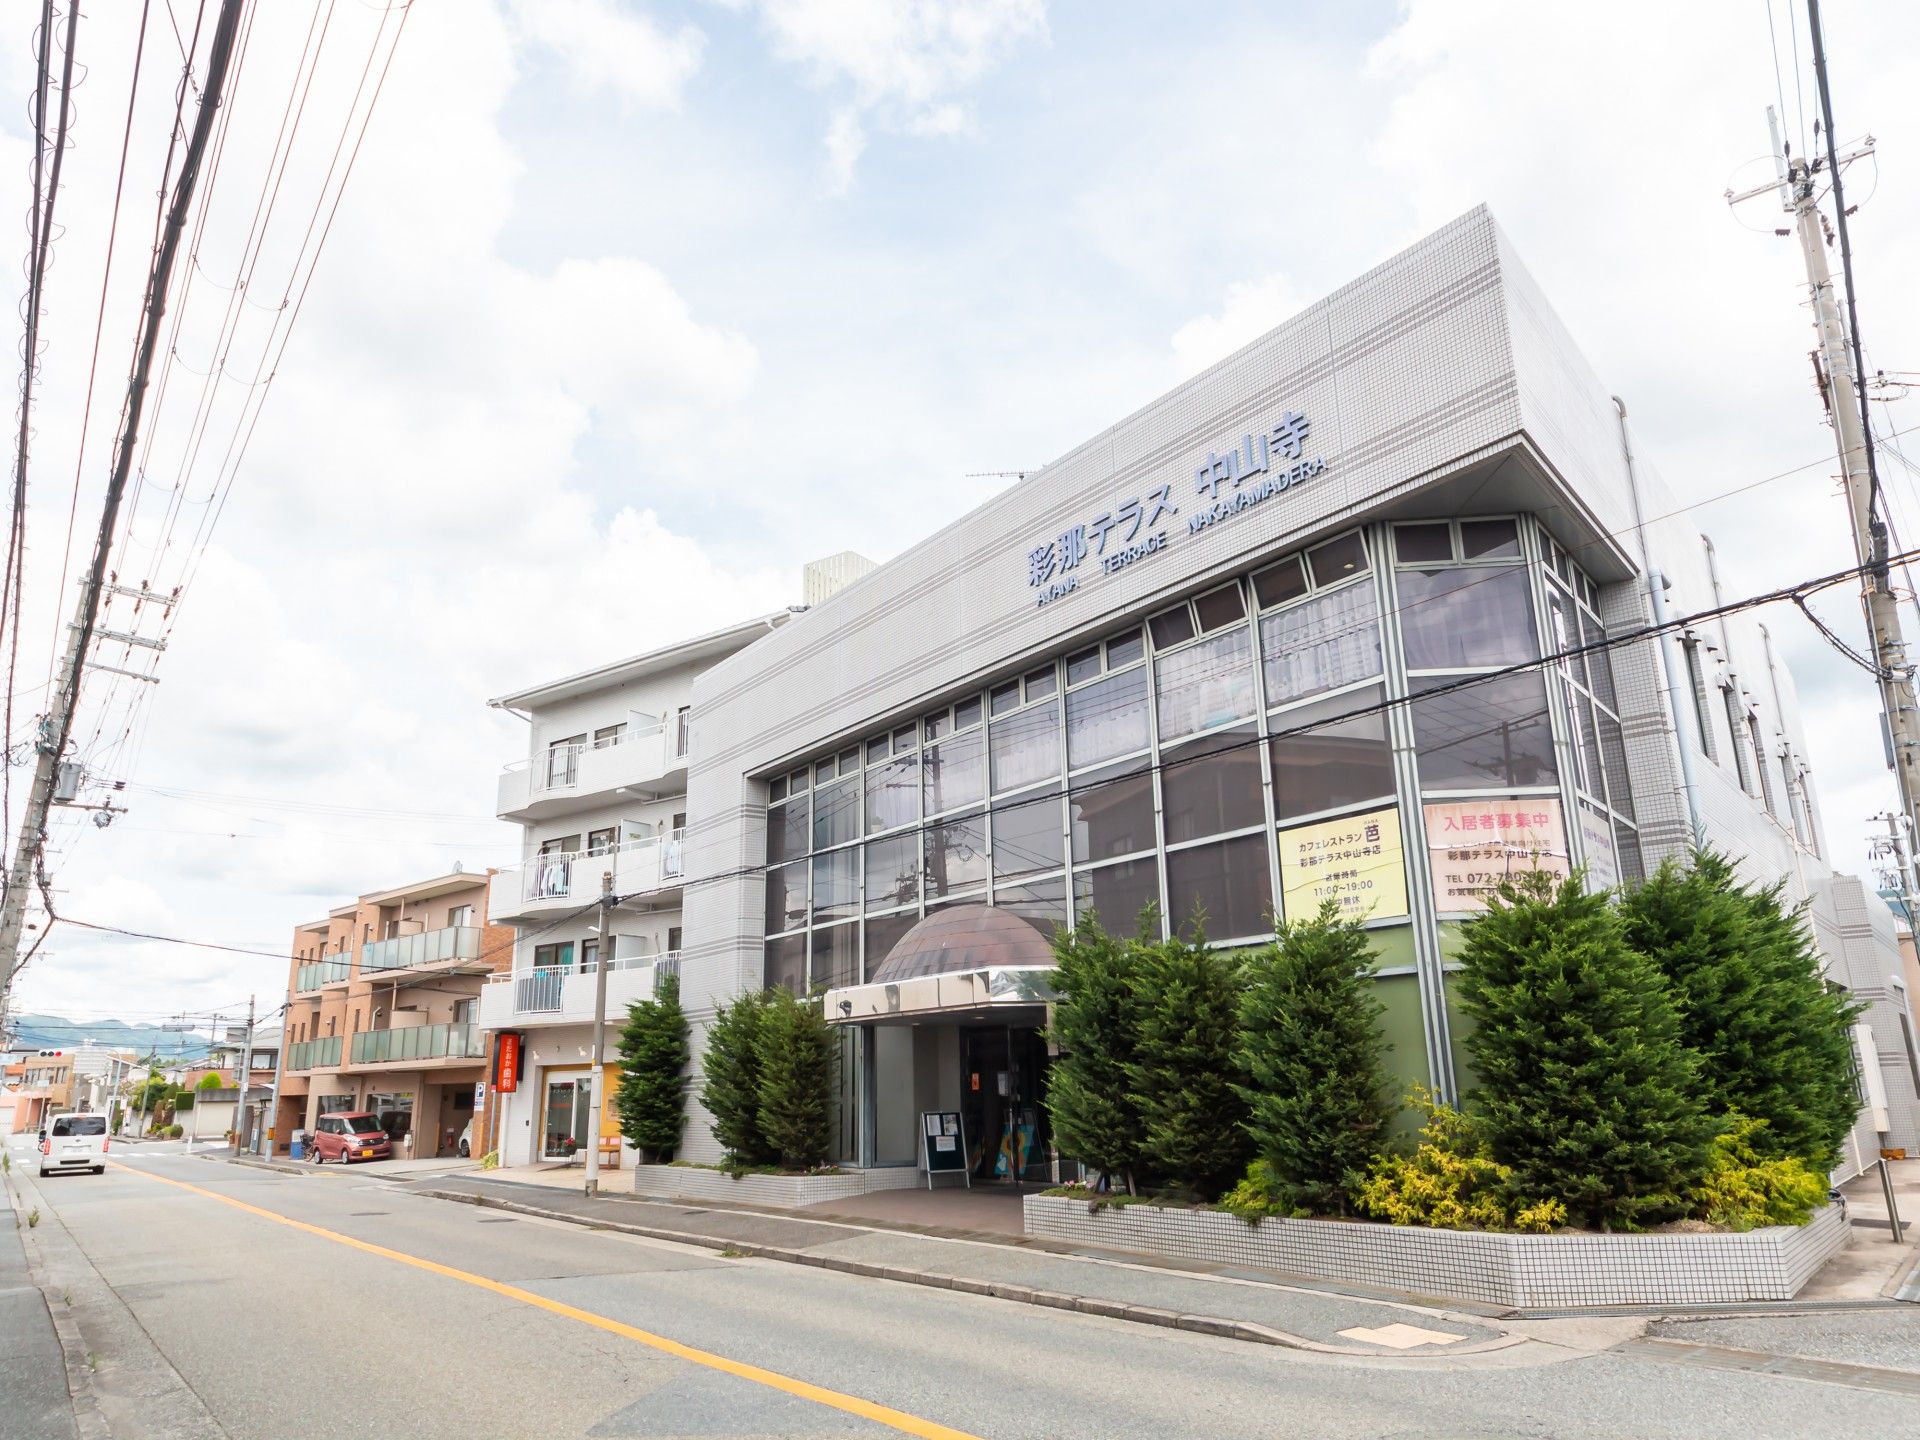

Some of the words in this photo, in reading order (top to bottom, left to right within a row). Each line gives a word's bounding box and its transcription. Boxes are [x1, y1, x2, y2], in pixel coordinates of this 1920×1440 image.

[1028, 483, 1178, 587] 彩那テラス
[1195, 409, 1310, 498] 中山寺
[1037, 574, 1080, 607] AYANA
[1100, 532, 1168, 575] TERRACE
[1187, 452, 1329, 534] NAKAYAMADERA
[1444, 812, 1549, 832] 入居者募集中
[1299, 833, 1362, 852] カフェレストラン
[1300, 845, 1381, 867] 彩那テラス中山寺店
[1445, 874, 1463, 884] TEL
